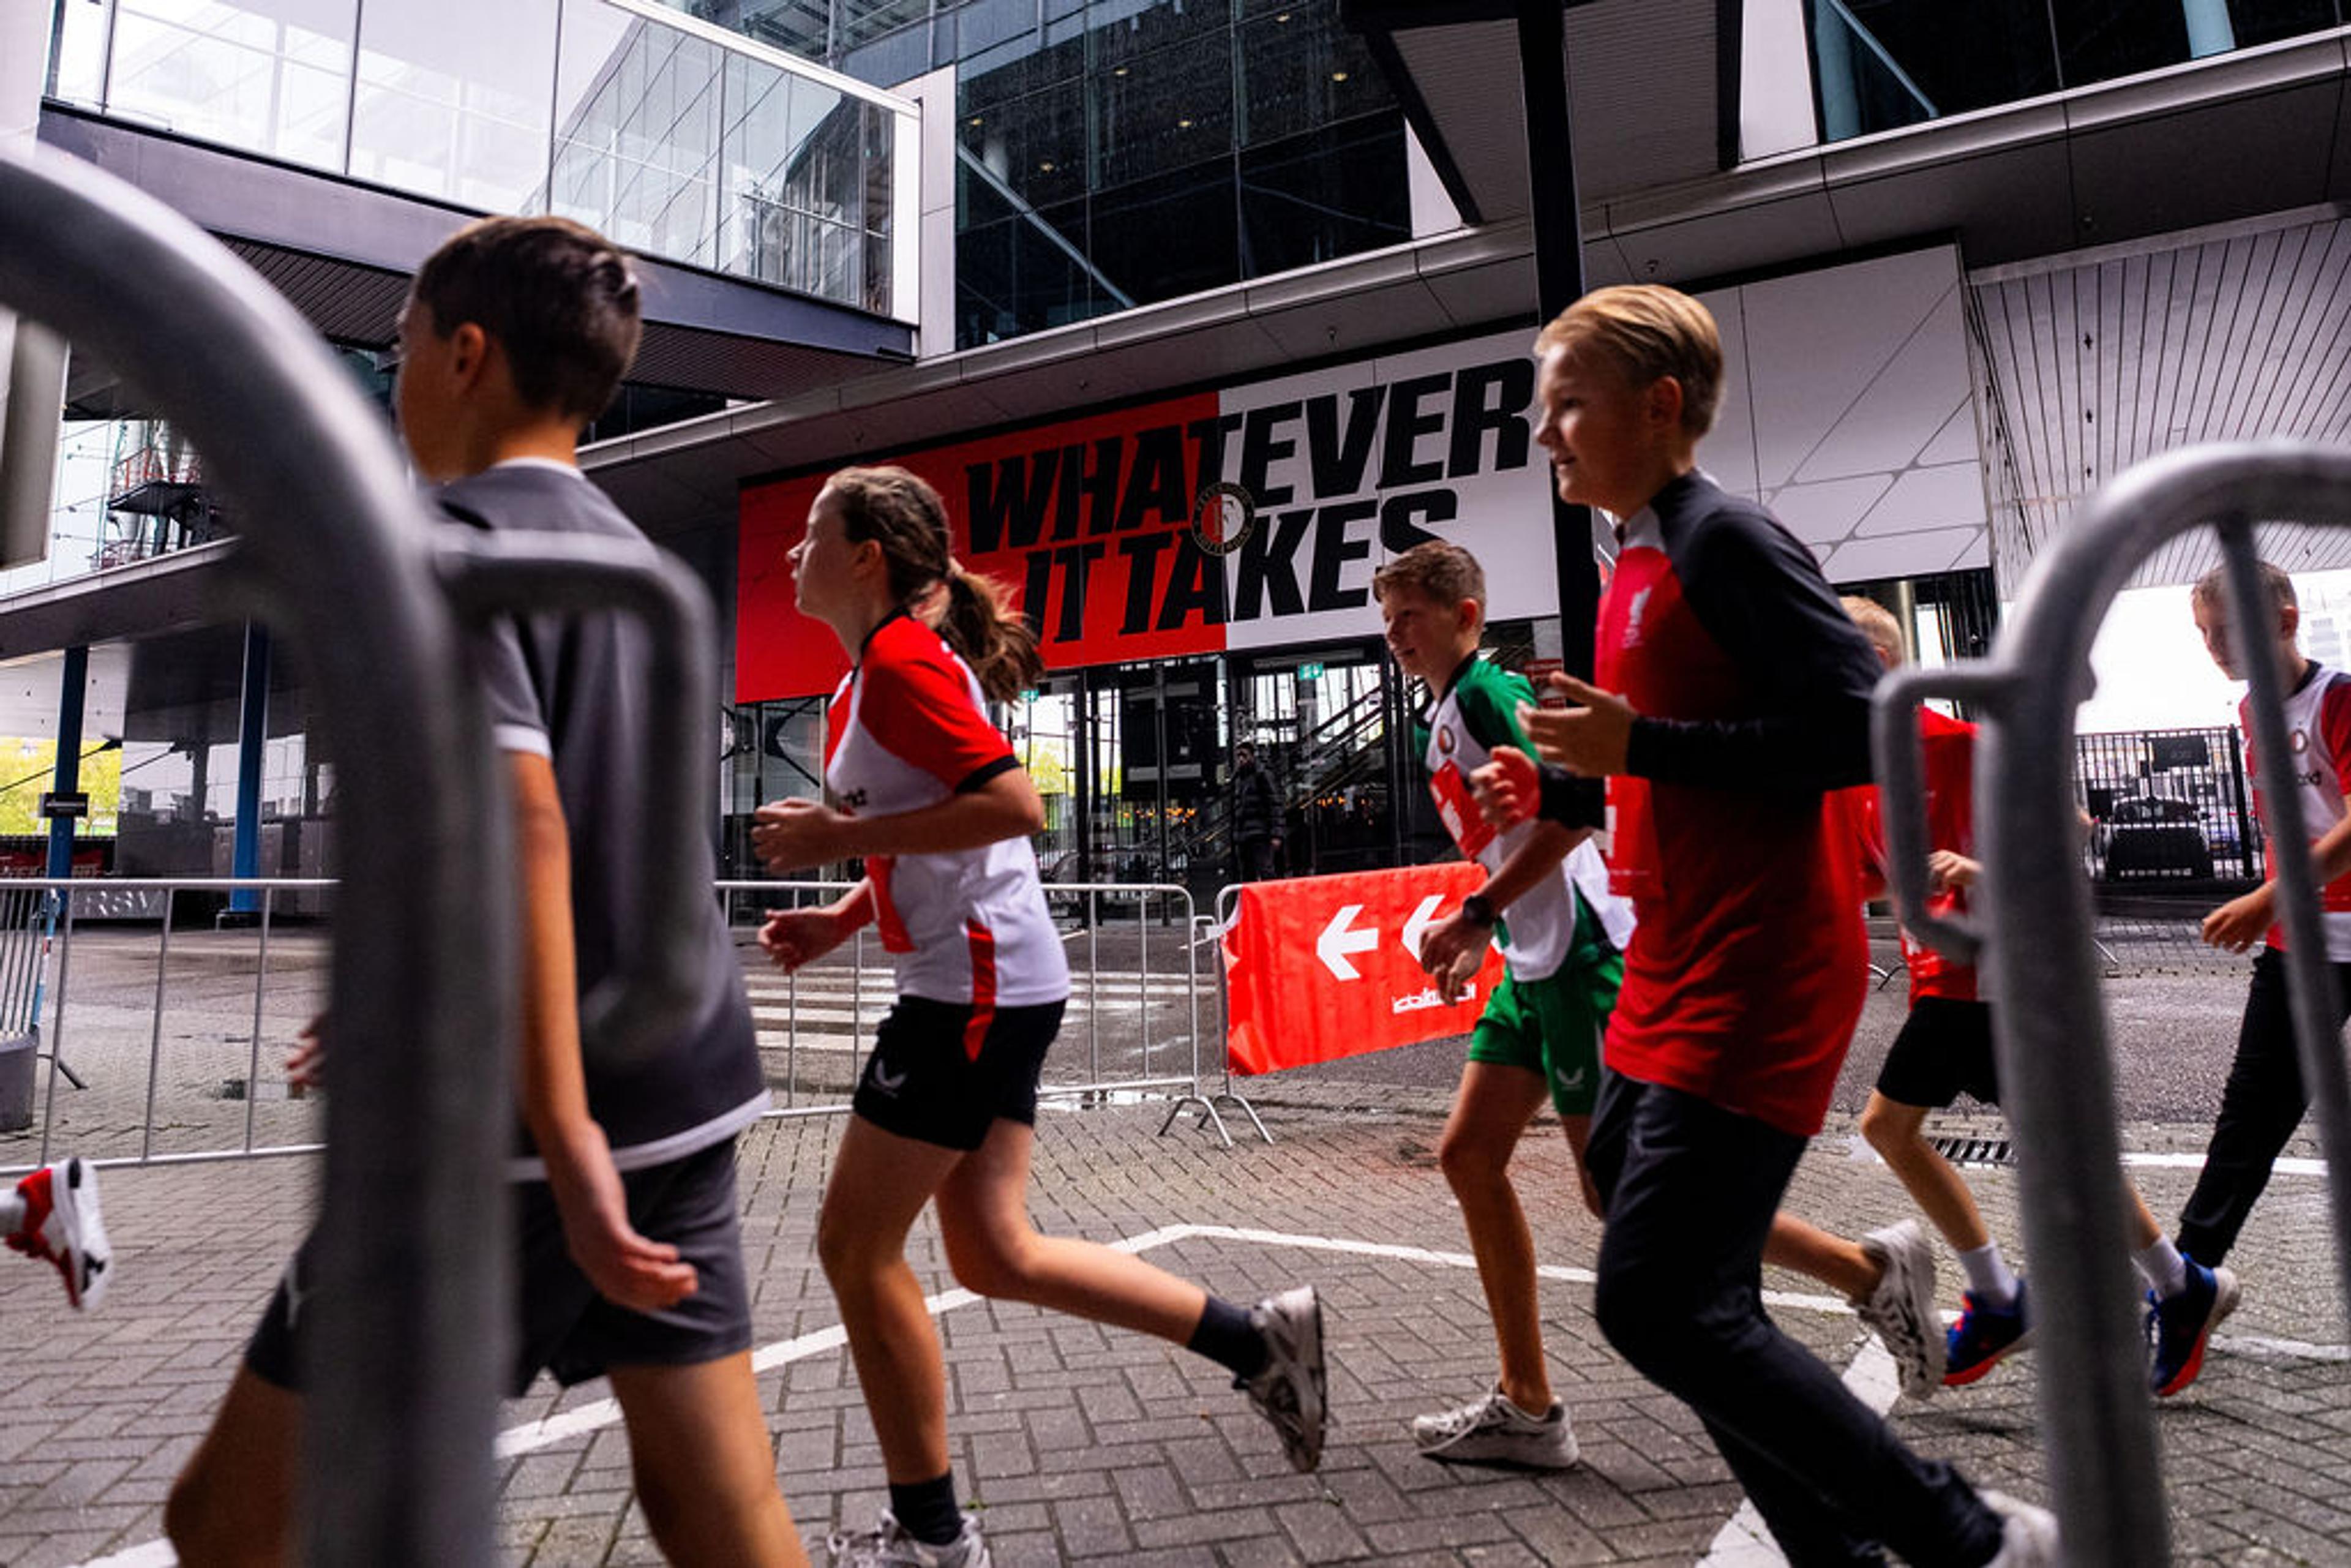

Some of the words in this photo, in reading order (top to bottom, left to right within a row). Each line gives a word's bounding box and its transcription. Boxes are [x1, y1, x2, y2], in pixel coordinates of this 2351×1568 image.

[966, 358, 1535, 554] WHATEVER
[1022, 541, 1105, 647] IT
[1118, 488, 1457, 636] TAKES
